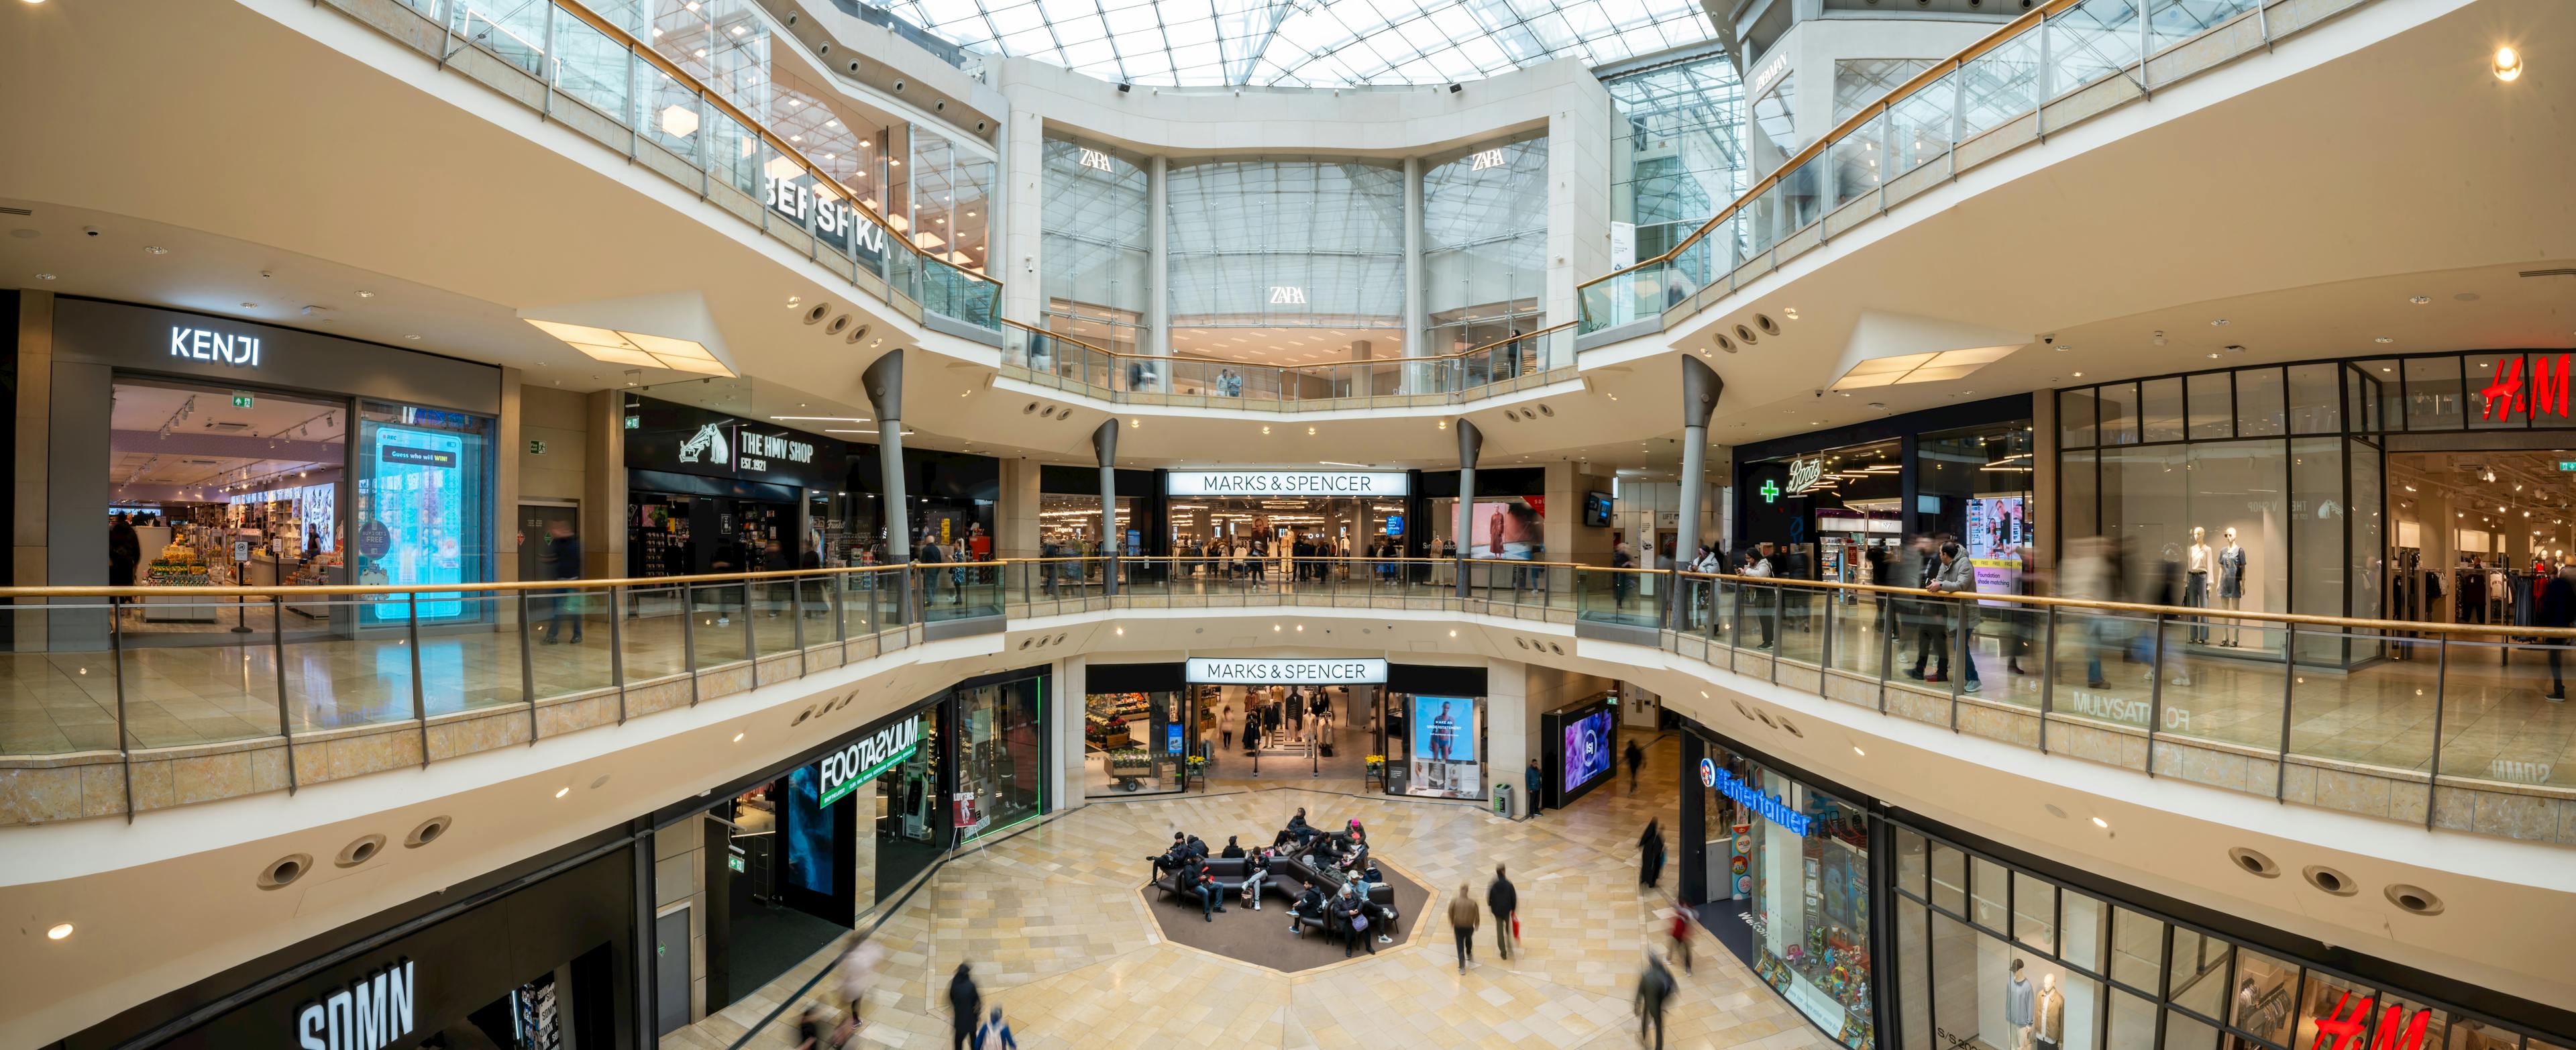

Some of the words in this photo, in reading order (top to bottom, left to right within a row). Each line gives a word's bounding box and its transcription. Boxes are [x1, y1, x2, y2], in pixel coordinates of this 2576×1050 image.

[1080, 148, 1113, 172] ZARA
[1472, 148, 1505, 171] ZARA
[1269, 286, 1307, 303] ZARA
[171, 327, 259, 366] KENJI
[2481, 352, 2570, 423] H&M
[741, 431, 763, 456] THE
[764, 435, 788, 460] HMV
[789, 441, 813, 464] SHOP
[741, 457, 766, 472] EST.1921
[1786, 459, 1820, 492] Boots
[1204, 476, 1267, 491] MARKS
[1271, 476, 1282, 491] &
[1286, 476, 1371, 491] SPENCER
[1990, 579, 2009, 588] matching
[1208, 664, 1267, 678] MARKS
[1271, 664, 1281, 678] &
[1285, 664, 1366, 678] SPENCER
[820, 715, 918, 794] FOOTASYLUM
[1721, 770, 1811, 837] Entertainer
[300, 961, 414, 1050] SDMN
[1937, 1027, 1957, 1045] S/S
[1958, 1039, 1980, 1050] 20
